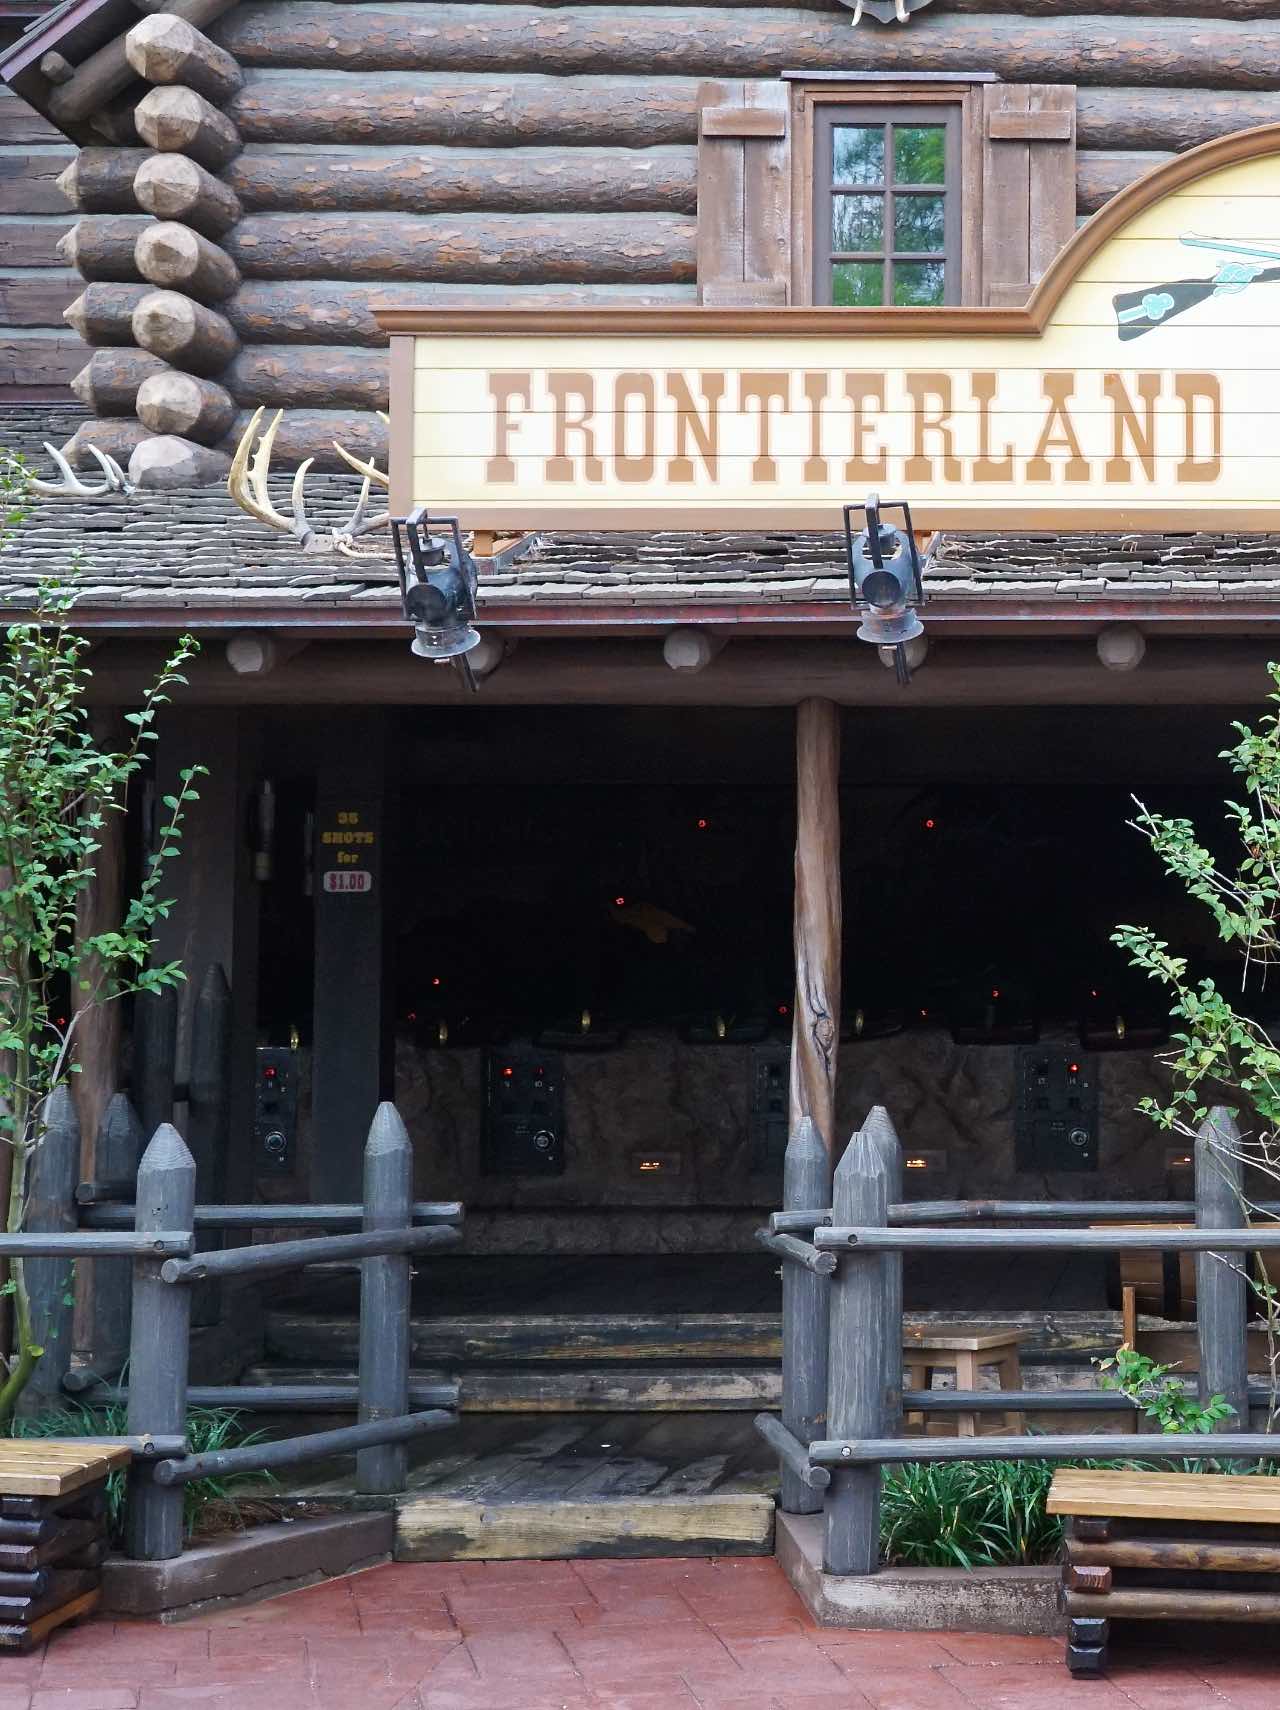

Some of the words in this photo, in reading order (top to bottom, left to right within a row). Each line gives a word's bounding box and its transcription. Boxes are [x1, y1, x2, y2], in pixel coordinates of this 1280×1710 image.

[484, 372, 1224, 485] FRONTIERLAND
[321, 831, 375, 844] SHOTS
[336, 851, 359, 864] for
[328, 873, 365, 891] $1.00
